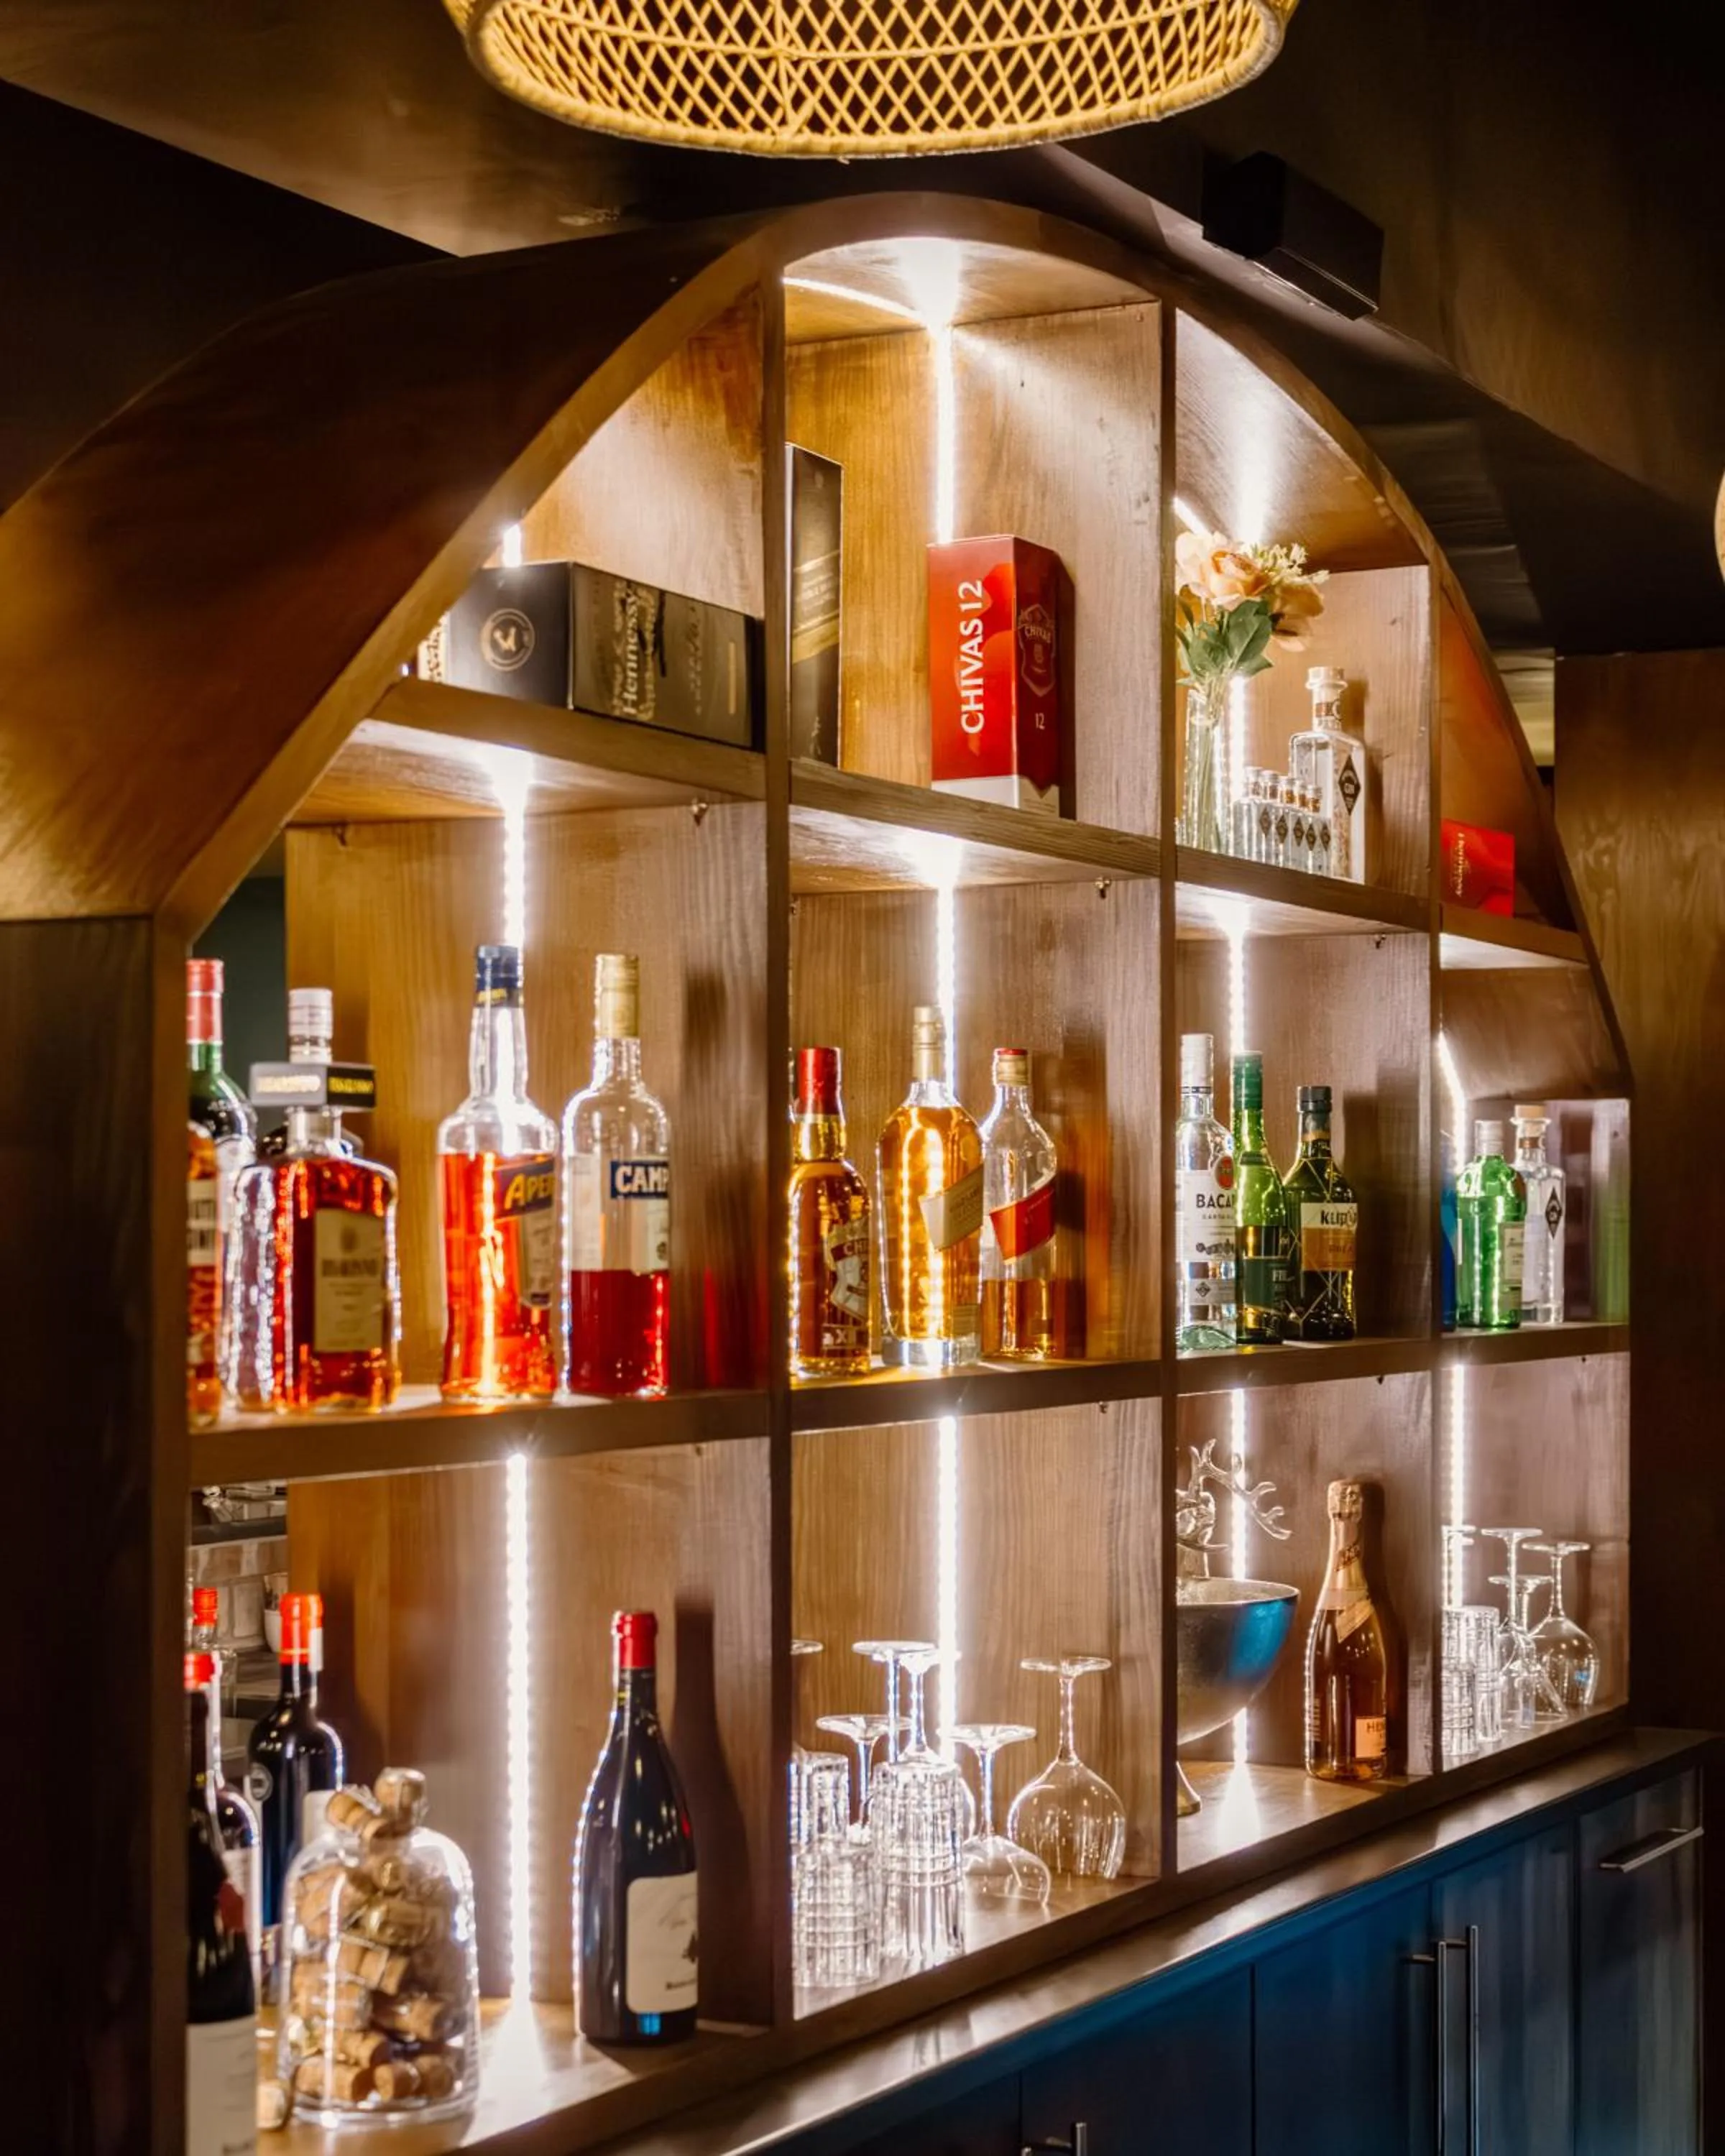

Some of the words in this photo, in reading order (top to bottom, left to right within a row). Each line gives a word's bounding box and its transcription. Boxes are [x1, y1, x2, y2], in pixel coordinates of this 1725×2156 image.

[958, 580, 983, 612] 12
[622, 591, 638, 714] Hennessy
[960, 618, 985, 734] CHIVAS
[1034, 712, 1045, 730] 12
